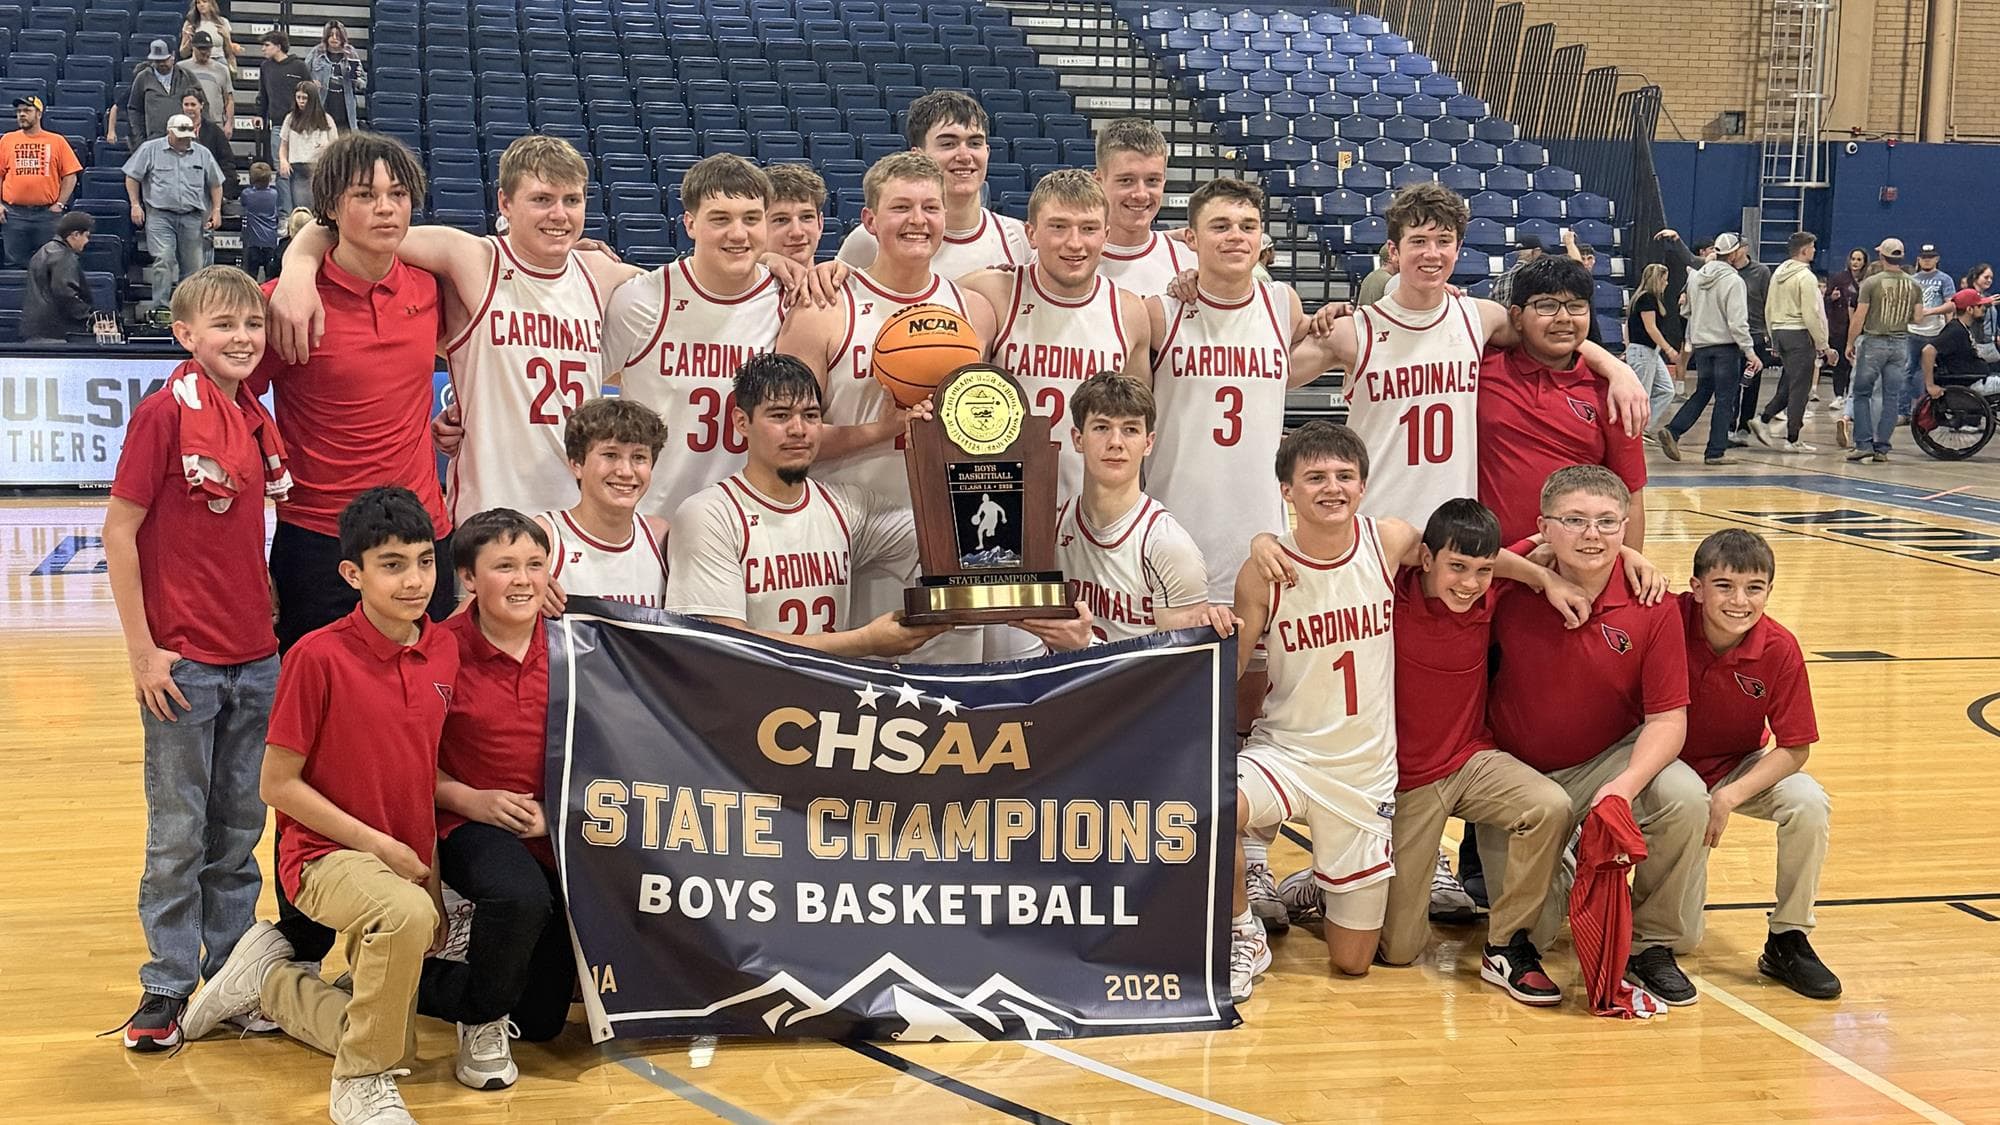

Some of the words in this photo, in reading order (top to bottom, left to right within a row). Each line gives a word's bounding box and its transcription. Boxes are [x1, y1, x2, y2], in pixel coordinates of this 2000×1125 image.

[14, 150, 41, 159] THAT
[15, 167, 41, 176] SPIRIT
[908, 318, 958, 334] NCAA
[1004, 343, 1122, 380] CARDINALS
[1171, 346, 1283, 380] CARDINALS
[1366, 361, 1477, 402] CARDINALS
[525, 356, 587, 425] 25
[1213, 386, 1243, 447] 3
[1400, 403, 1454, 466] 10
[958, 472, 1014, 481] BASKETBALL
[974, 464, 997, 472] BOYS
[745, 551, 848, 594] CARDINALS
[948, 575, 981, 585] STATE
[983, 573, 1038, 584] CHAMPION
[1278, 599, 1392, 653] CARDINALS
[1332, 650, 1358, 717] 1
[756, 706, 1031, 775] CHSAA
[581, 778, 783, 858] STATE
[806, 797, 1198, 864] CHAMPIONS
[638, 873, 777, 923] BOYS
[796, 881, 1139, 926] BASKETBALL
[1104, 973, 1181, 1001] 2026
